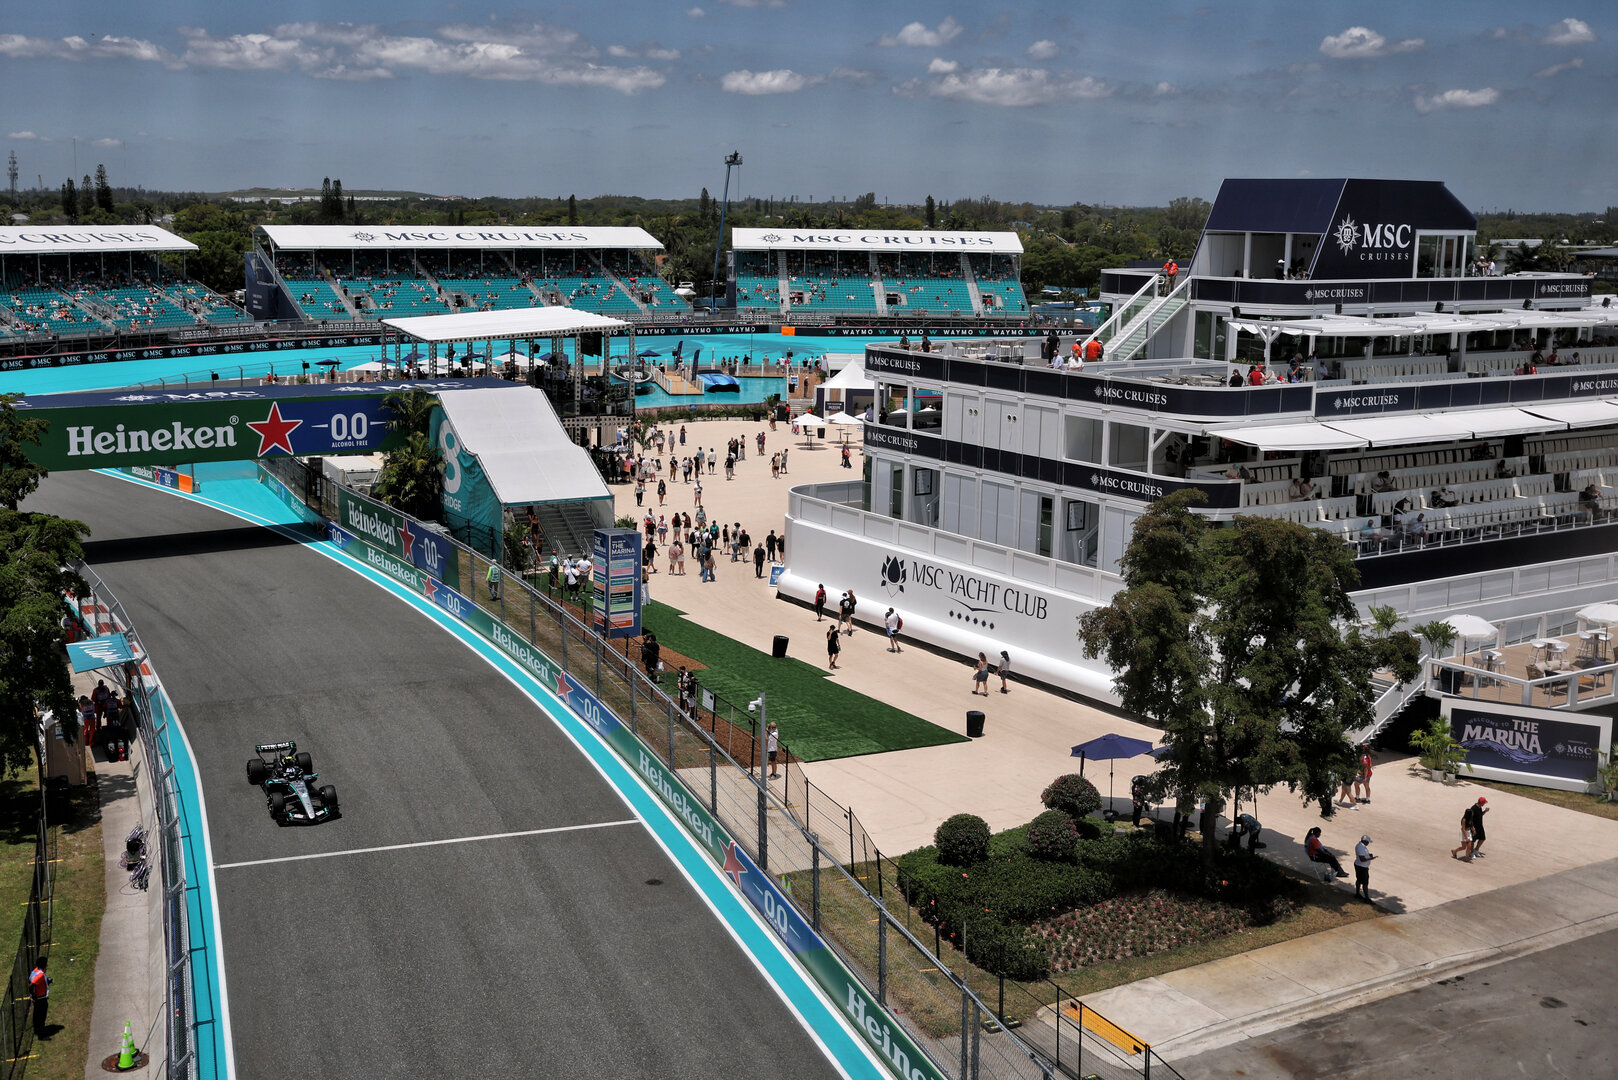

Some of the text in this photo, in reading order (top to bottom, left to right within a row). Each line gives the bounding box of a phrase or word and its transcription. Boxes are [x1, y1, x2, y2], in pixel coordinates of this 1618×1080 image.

[18, 233, 158, 243] CRUISES
[384, 232, 588, 240] MSC CRUISES
[792, 235, 993, 245] MSC CRUISES
[1362, 224, 1411, 248] MSC
[1314, 289, 1364, 298] MSC CRUISES
[874, 356, 920, 370] MSC CRUISES
[1580, 379, 1618, 390] MSC CRUIS
[1103, 388, 1167, 405] MSC CRUISES
[1343, 395, 1398, 407] MSC CRUISES
[331, 413, 368, 440] 0.0
[872, 432, 918, 448] MSC CRUISES
[440, 420, 461, 494] 8
[1100, 476, 1162, 496] MSC CRUISES
[443, 494, 461, 511] RIDGE
[348, 500, 396, 546] Heineken
[332, 528, 342, 544] 0.0
[424, 538, 437, 569] 0.0
[367, 548, 418, 586] Heineken
[912, 561, 1047, 619] MSC YACHT CLUB
[448, 594, 460, 613] 0.0
[492, 622, 550, 681] Heineken
[584, 699, 600, 726] 0.0
[1512, 720, 1539, 733] THE
[1461, 725, 1544, 754] MARINA
[1567, 745, 1592, 755] MSC
[764, 890, 787, 933] 0.0
